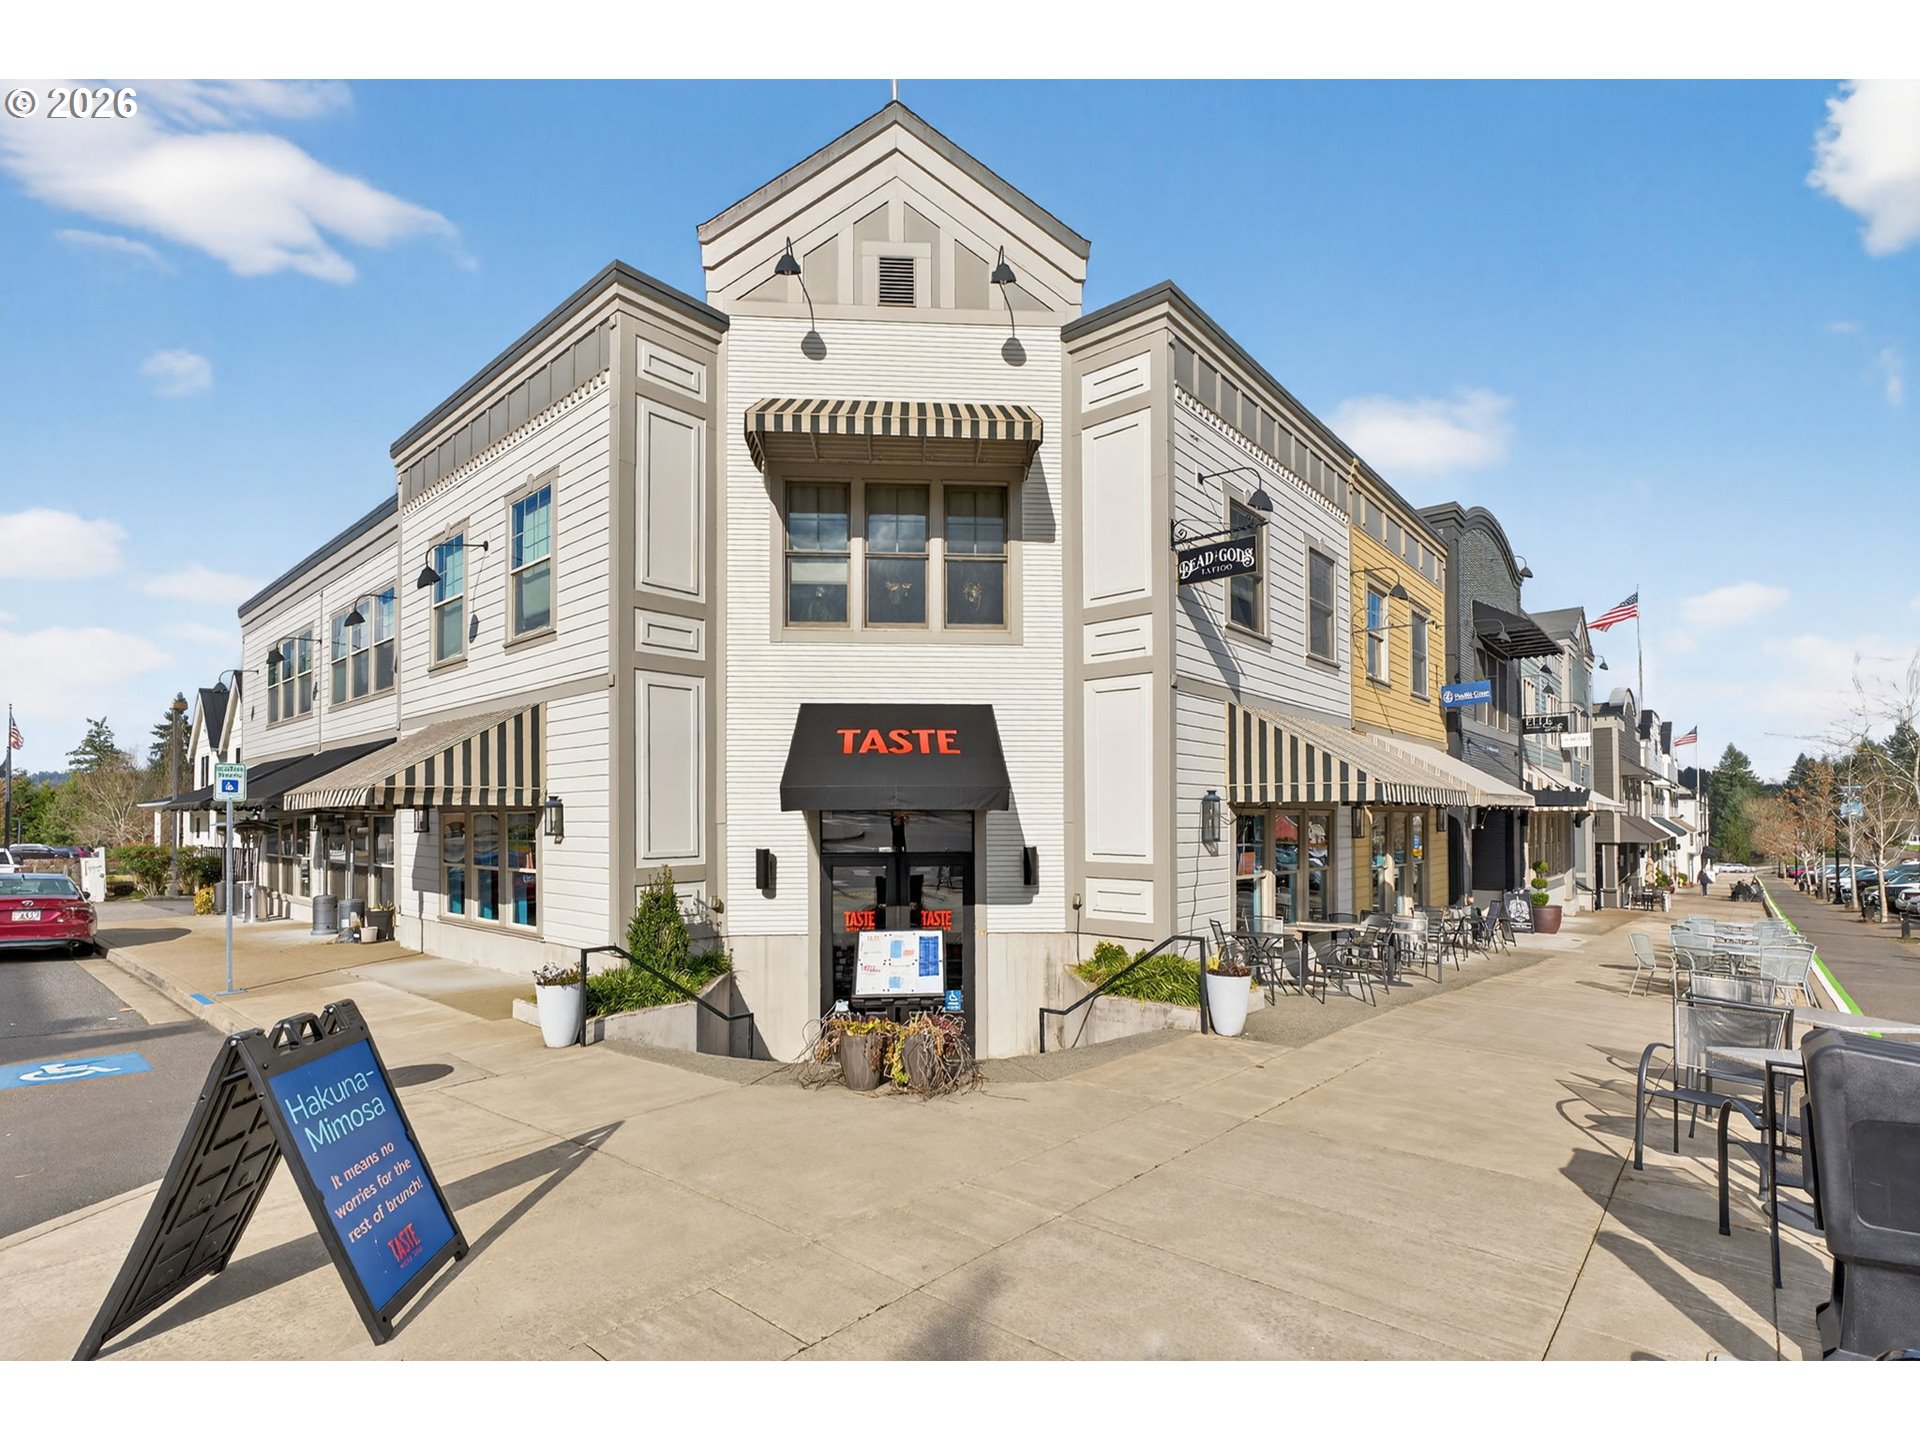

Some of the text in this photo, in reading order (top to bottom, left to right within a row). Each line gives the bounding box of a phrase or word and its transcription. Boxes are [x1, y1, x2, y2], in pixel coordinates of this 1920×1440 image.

[1179, 547, 1255, 579] DEAD GODS
[837, 729, 961, 754] TASTE
[844, 911, 876, 927] TASTE
[921, 910, 952, 926] TASTE
[285, 1070, 374, 1125] Hakuna-
[304, 1097, 386, 1153] Mimosa
[330, 1142, 395, 1190] It means no
[335, 1159, 412, 1219] worries for the
[348, 1175, 424, 1243] rest of brunch!
[387, 1223, 421, 1262] TASTE
